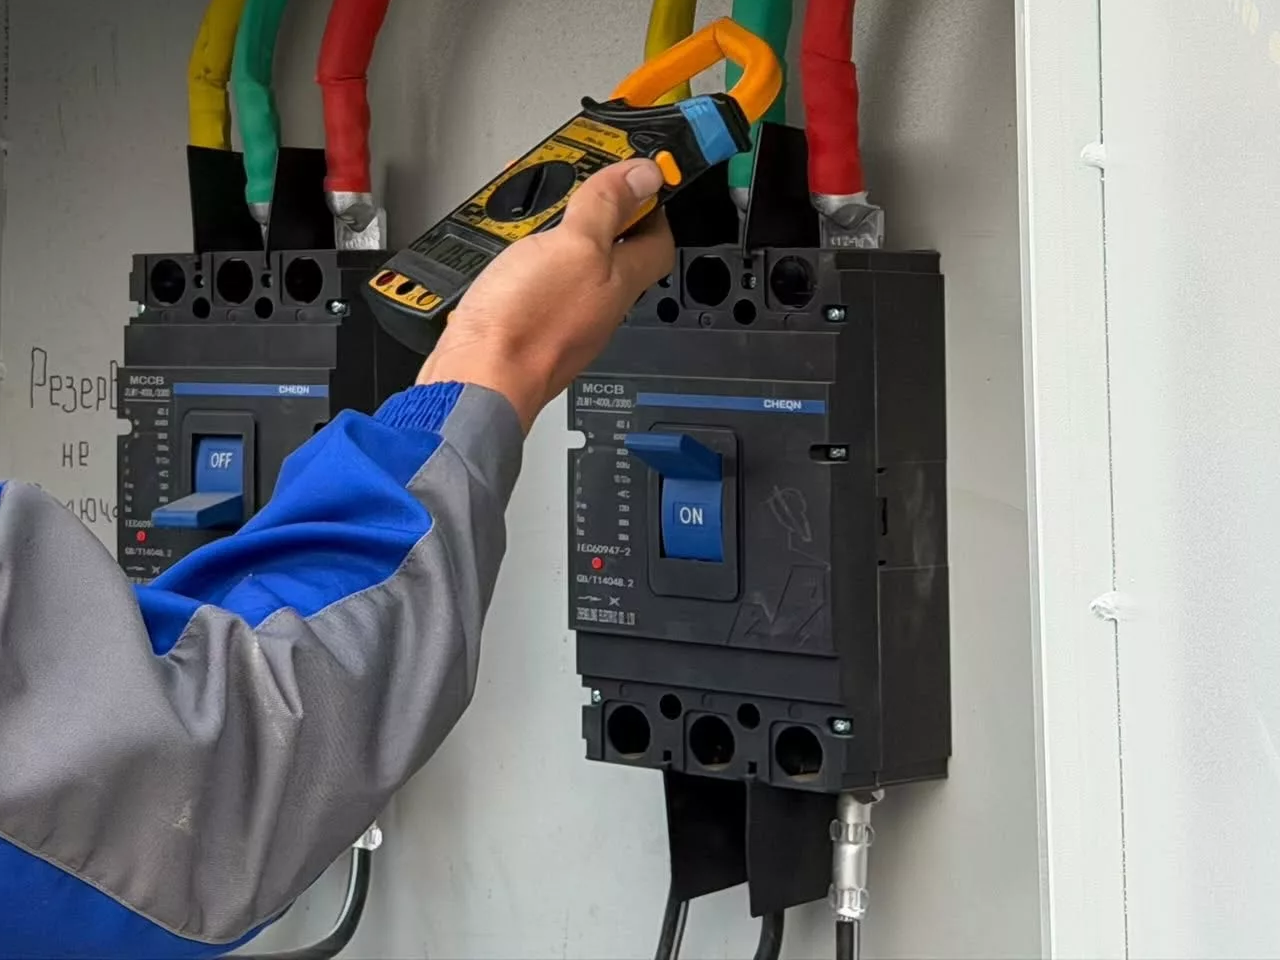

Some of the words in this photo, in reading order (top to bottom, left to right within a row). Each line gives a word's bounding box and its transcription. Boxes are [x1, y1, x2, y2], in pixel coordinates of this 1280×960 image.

[129, 375, 165, 386] MCCB
[582, 383, 625, 395] MCCB
[210, 451, 233, 469] OFF
[679, 506, 704, 525] ON
